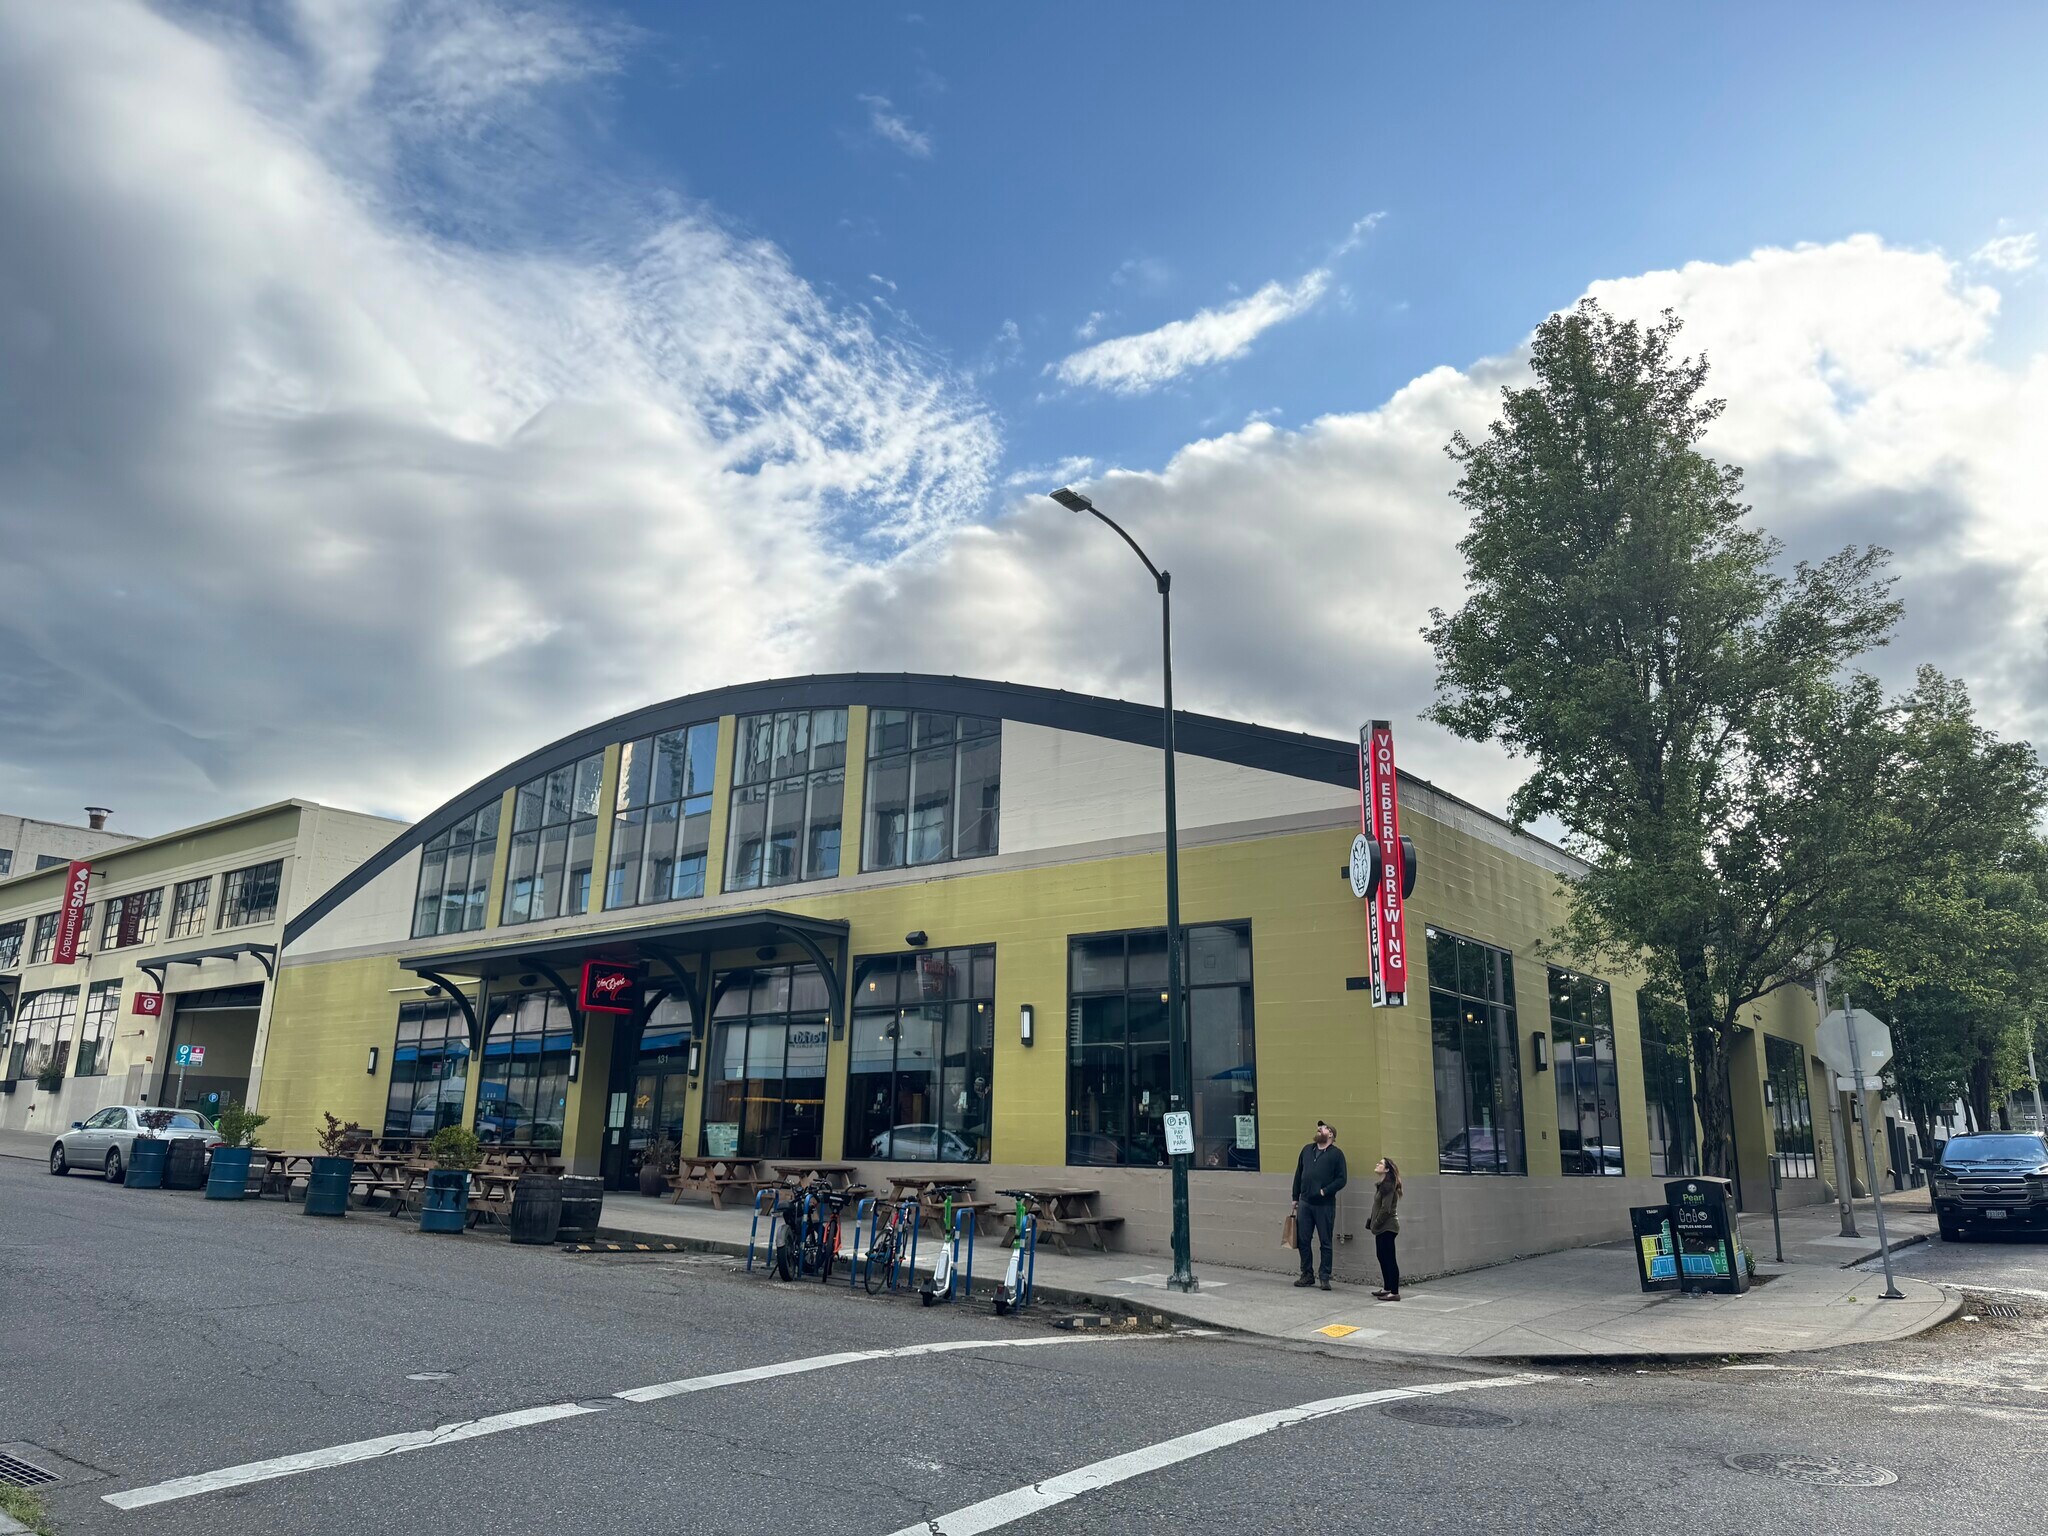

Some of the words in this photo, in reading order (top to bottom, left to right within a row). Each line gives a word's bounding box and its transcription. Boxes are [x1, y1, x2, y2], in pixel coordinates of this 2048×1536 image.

[1378, 734, 1391, 776] VON
[1381, 782, 1394, 854] EBERT
[71, 881, 87, 908] CVS
[1363, 768, 1371, 832] EBERT
[1370, 901, 1381, 1000] BREWING
[60, 908, 79, 958] pharmacy
[1384, 864, 1402, 969] BREWING
[179, 1054, 187, 1063] 2
[657, 1054, 669, 1064] 131
[1682, 1193, 1705, 1202] Pearl
